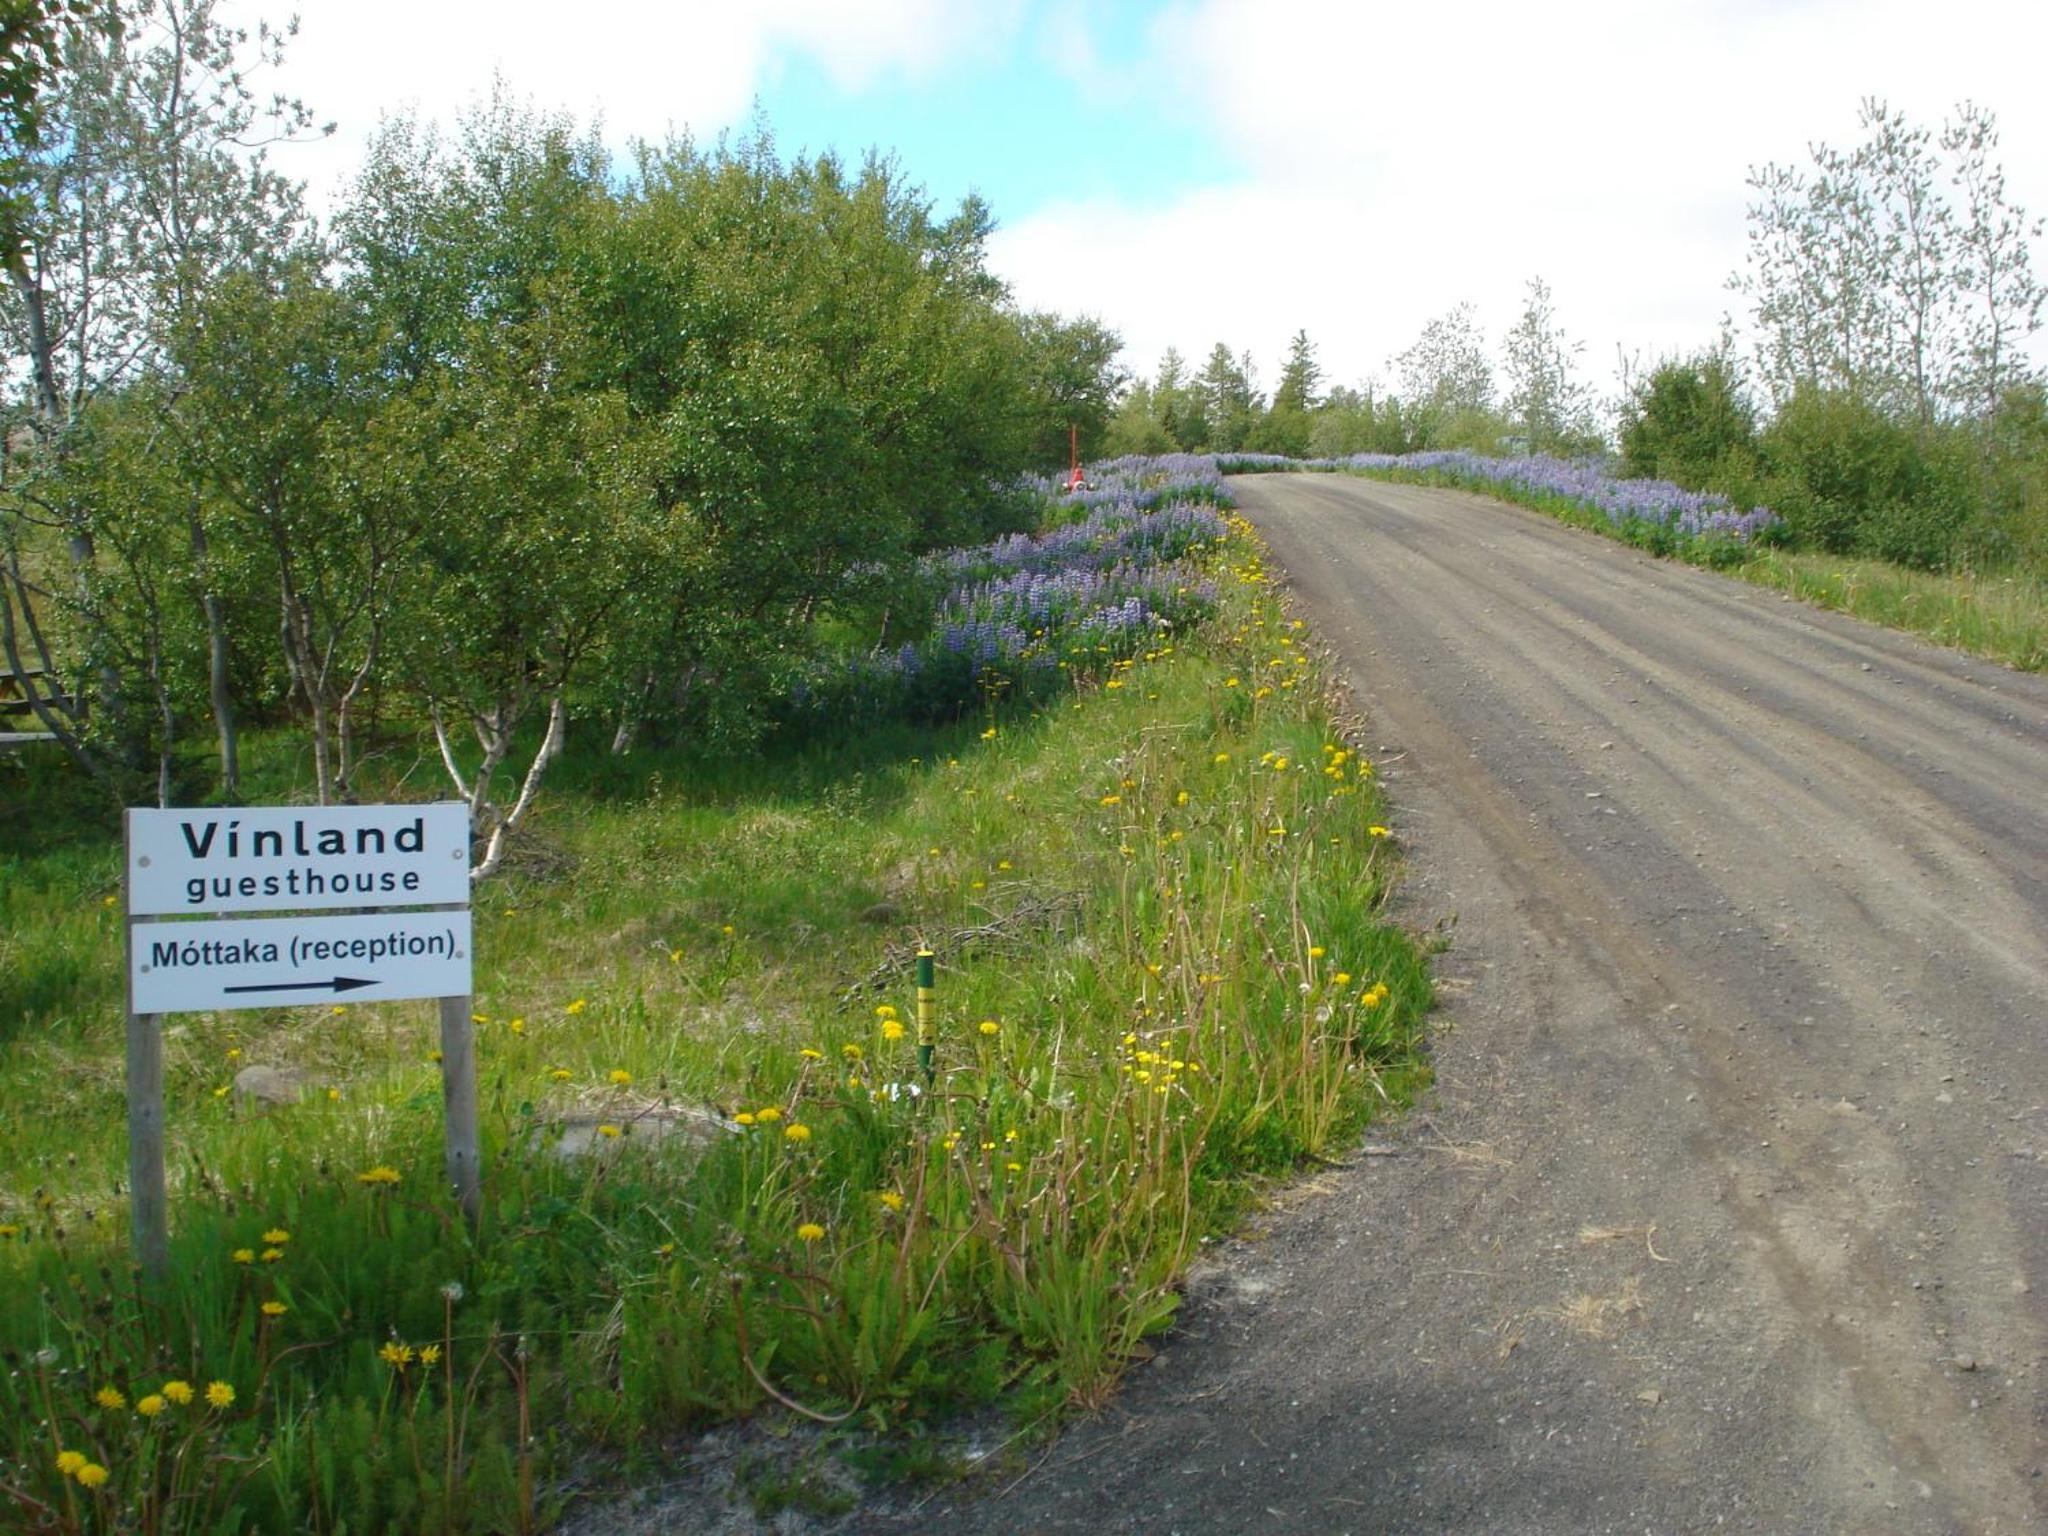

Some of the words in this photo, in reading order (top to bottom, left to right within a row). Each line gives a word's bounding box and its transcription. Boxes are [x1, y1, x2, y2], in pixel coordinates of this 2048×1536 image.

[180, 818, 424, 858] Vínland
[186, 868, 420, 904] guesthouse
[152, 938, 278, 968] Móttaka
[290, 929, 455, 968] (reception)
